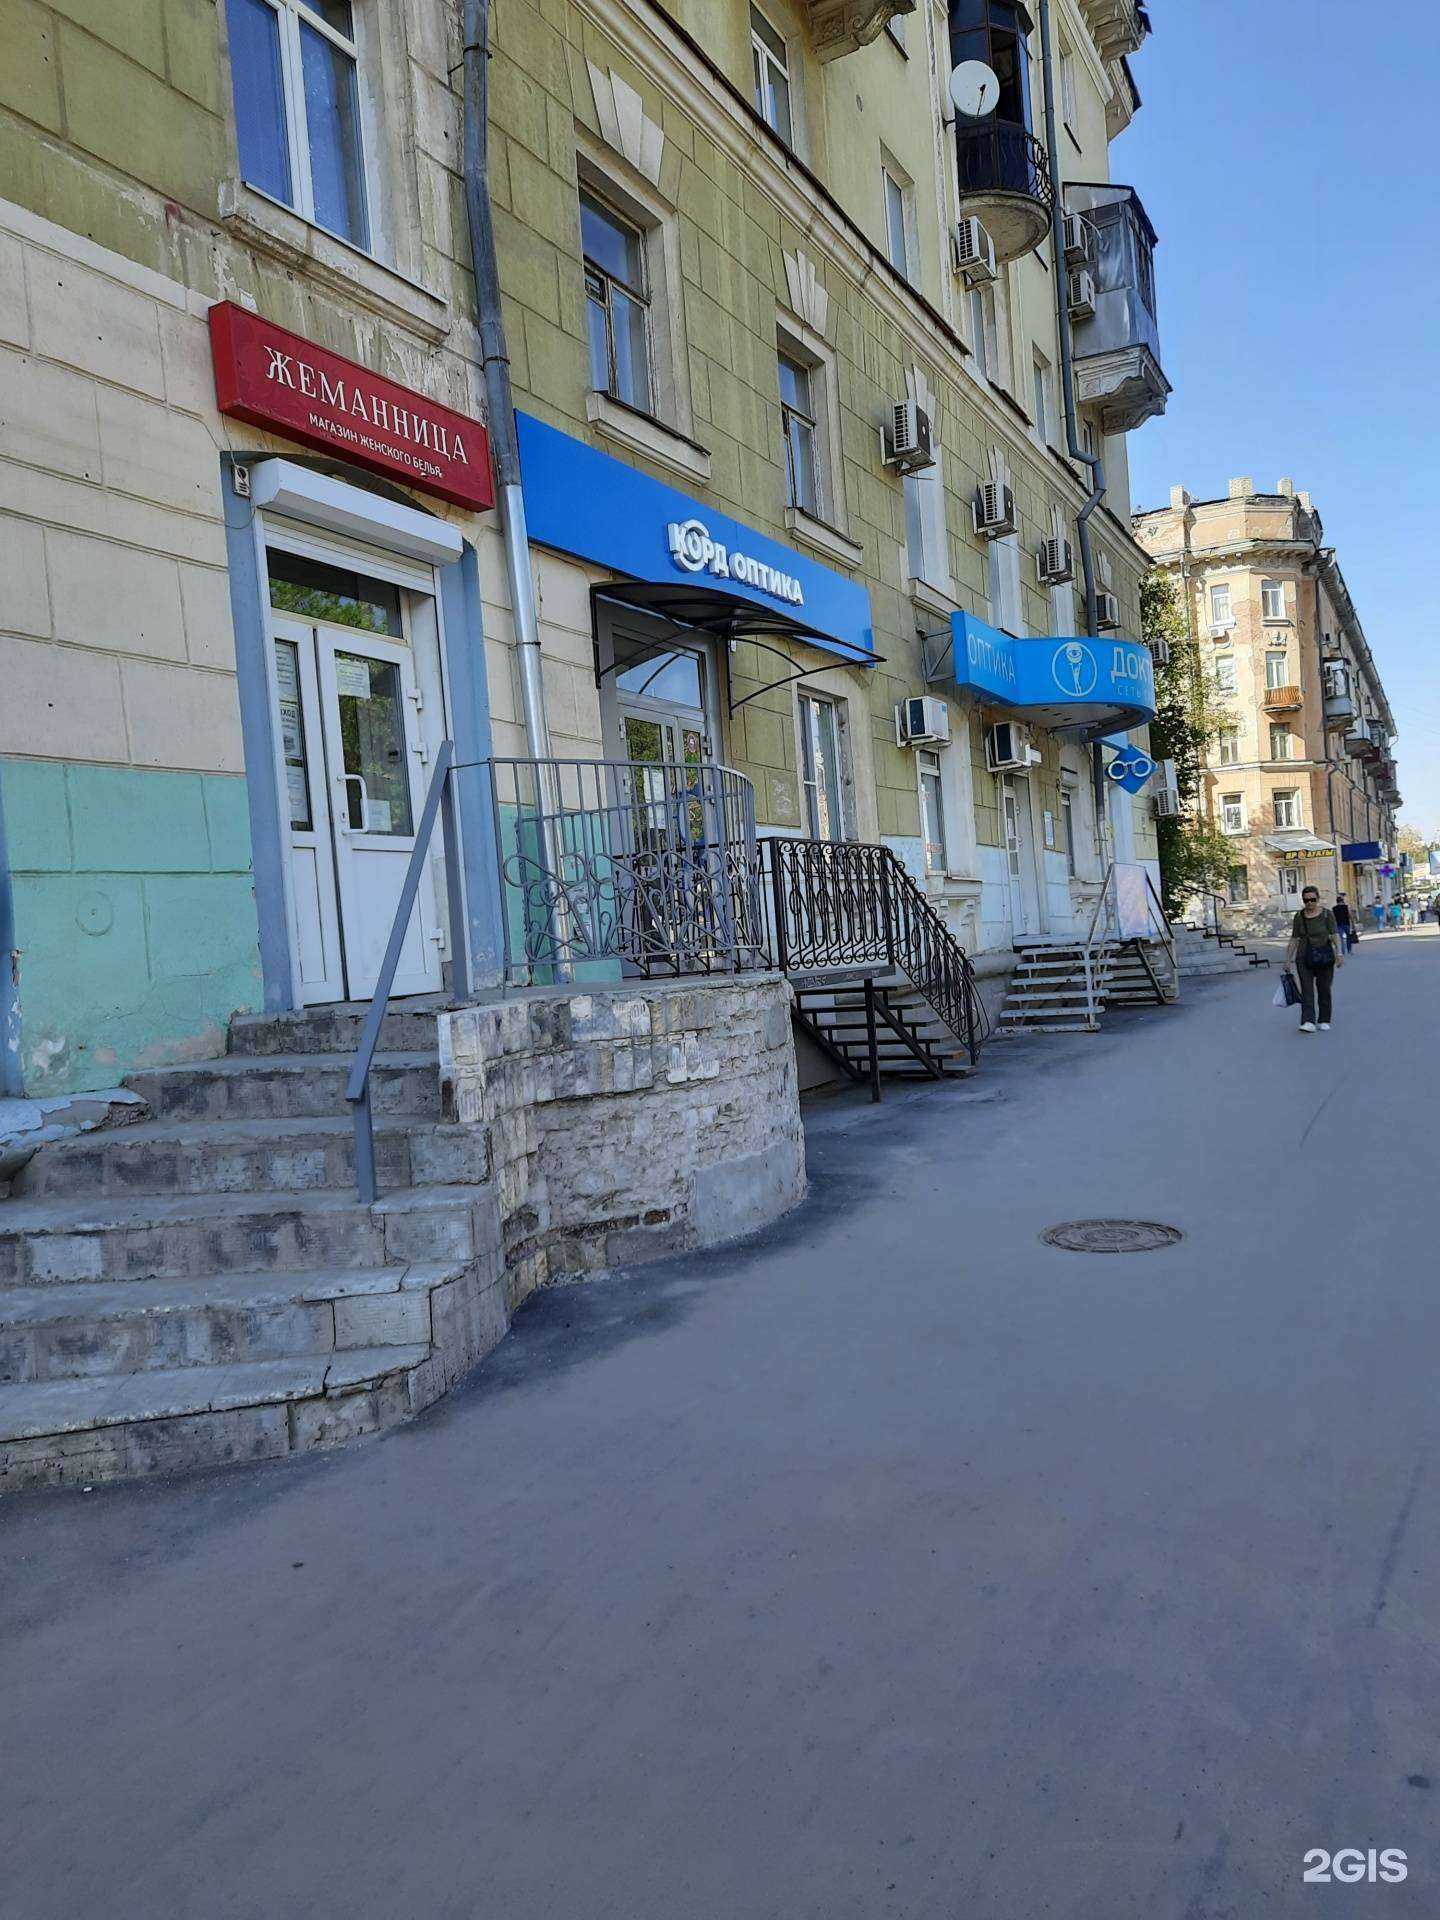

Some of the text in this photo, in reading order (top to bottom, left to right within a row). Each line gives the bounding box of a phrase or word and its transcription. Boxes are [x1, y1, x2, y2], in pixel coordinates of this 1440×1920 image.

[263, 345, 469, 465] ЖЕМАННИЦА
[309, 413, 442, 478] МАГАЗИН ЖЕНСКОГО БЕЛЬЯ
[667, 519, 804, 606] КОРД ОПТИКА
[968, 633, 1017, 685] ОПТИКА
